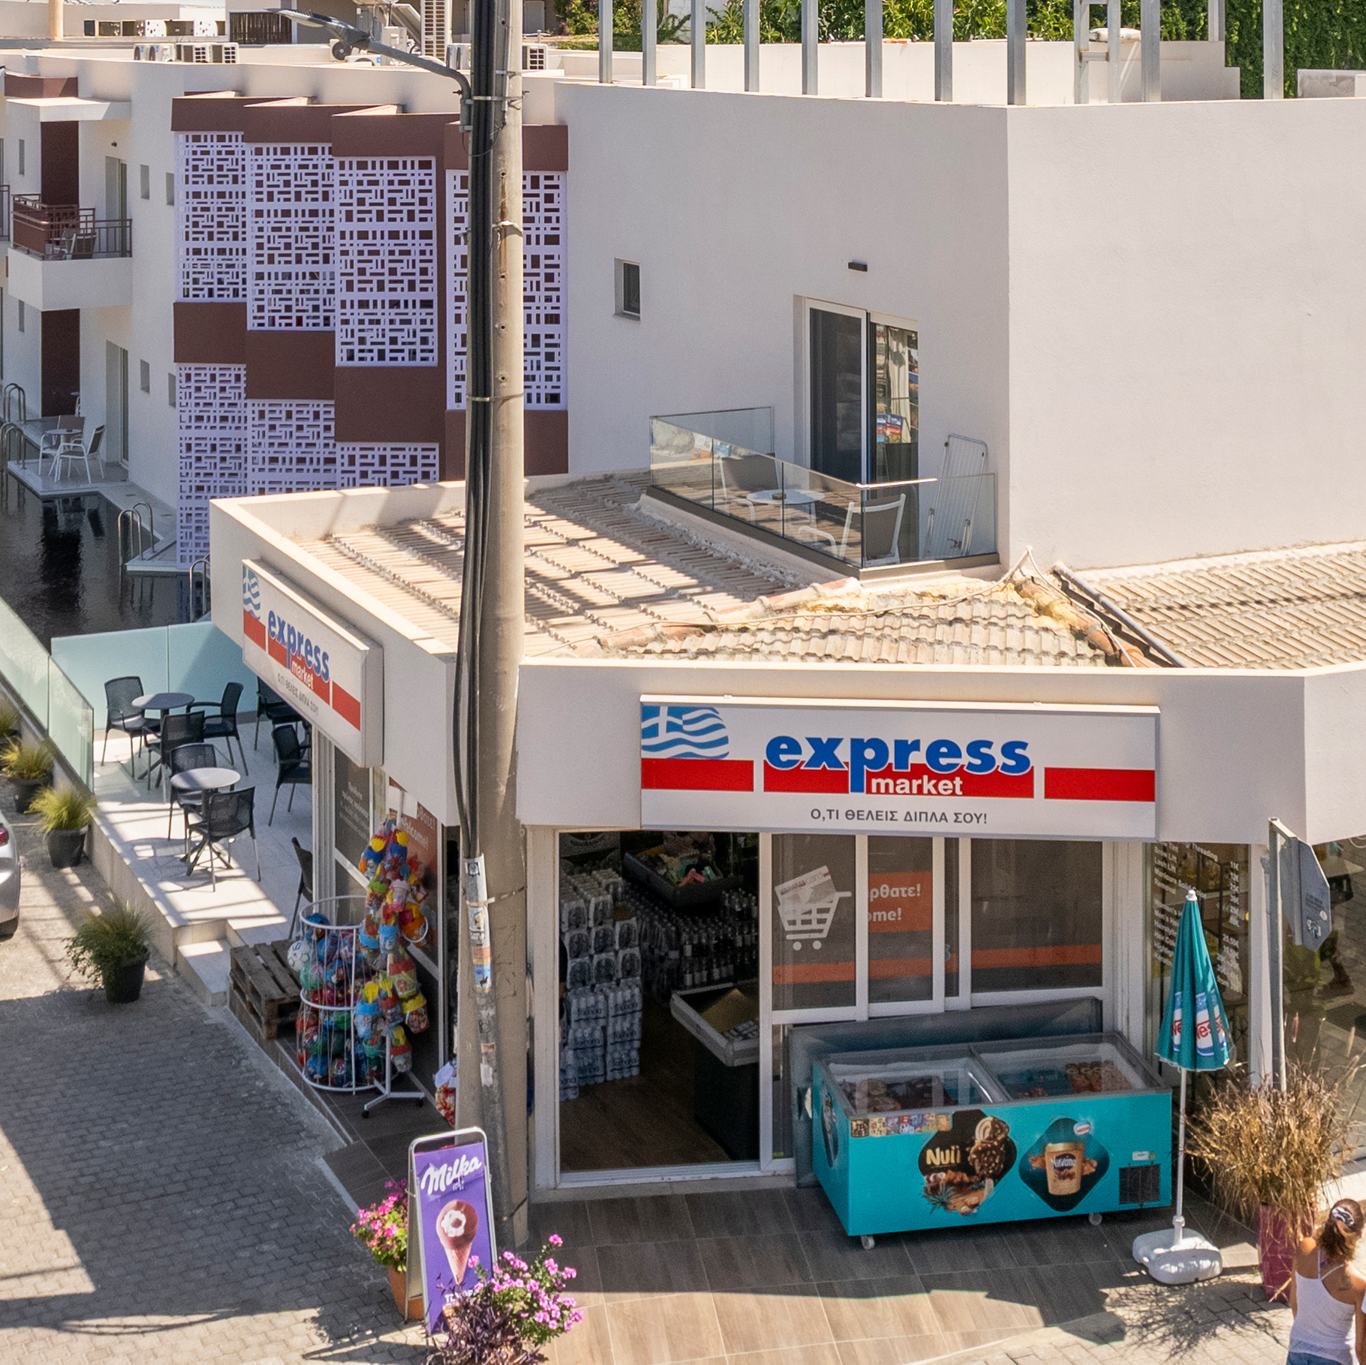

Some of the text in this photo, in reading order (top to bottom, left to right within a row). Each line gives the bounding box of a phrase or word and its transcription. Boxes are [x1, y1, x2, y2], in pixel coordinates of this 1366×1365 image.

[267, 610, 330, 682] express
[291, 661, 314, 690] market
[765, 735, 1032, 794] express
[870, 775, 963, 796] market
[844, 809, 899, 822] ΘΕΛΕΙΣ
[903, 811, 949, 824] ΔΙΠΛΑ
[953, 812, 988, 825] ΣΟΥ!
[420, 1154, 482, 1195] Milka
